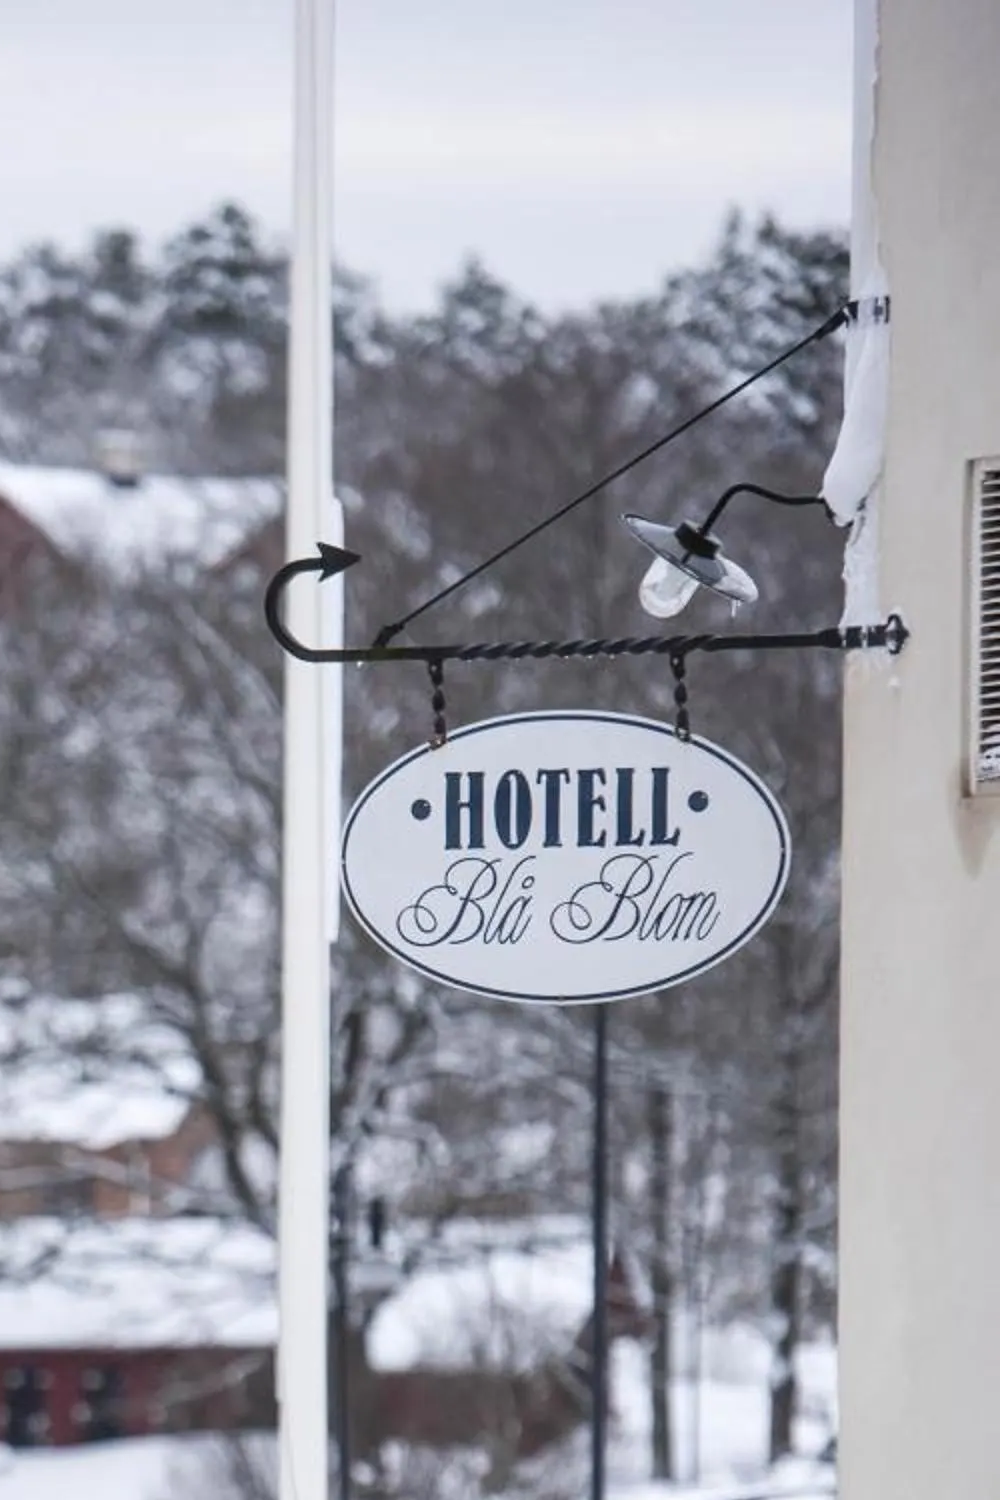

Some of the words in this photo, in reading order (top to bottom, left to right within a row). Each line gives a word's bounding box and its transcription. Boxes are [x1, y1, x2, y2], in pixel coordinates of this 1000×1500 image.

[444, 767, 681, 850] HOTELL
[396, 855, 537, 947] Blå
[549, 852, 721, 944] Blom
